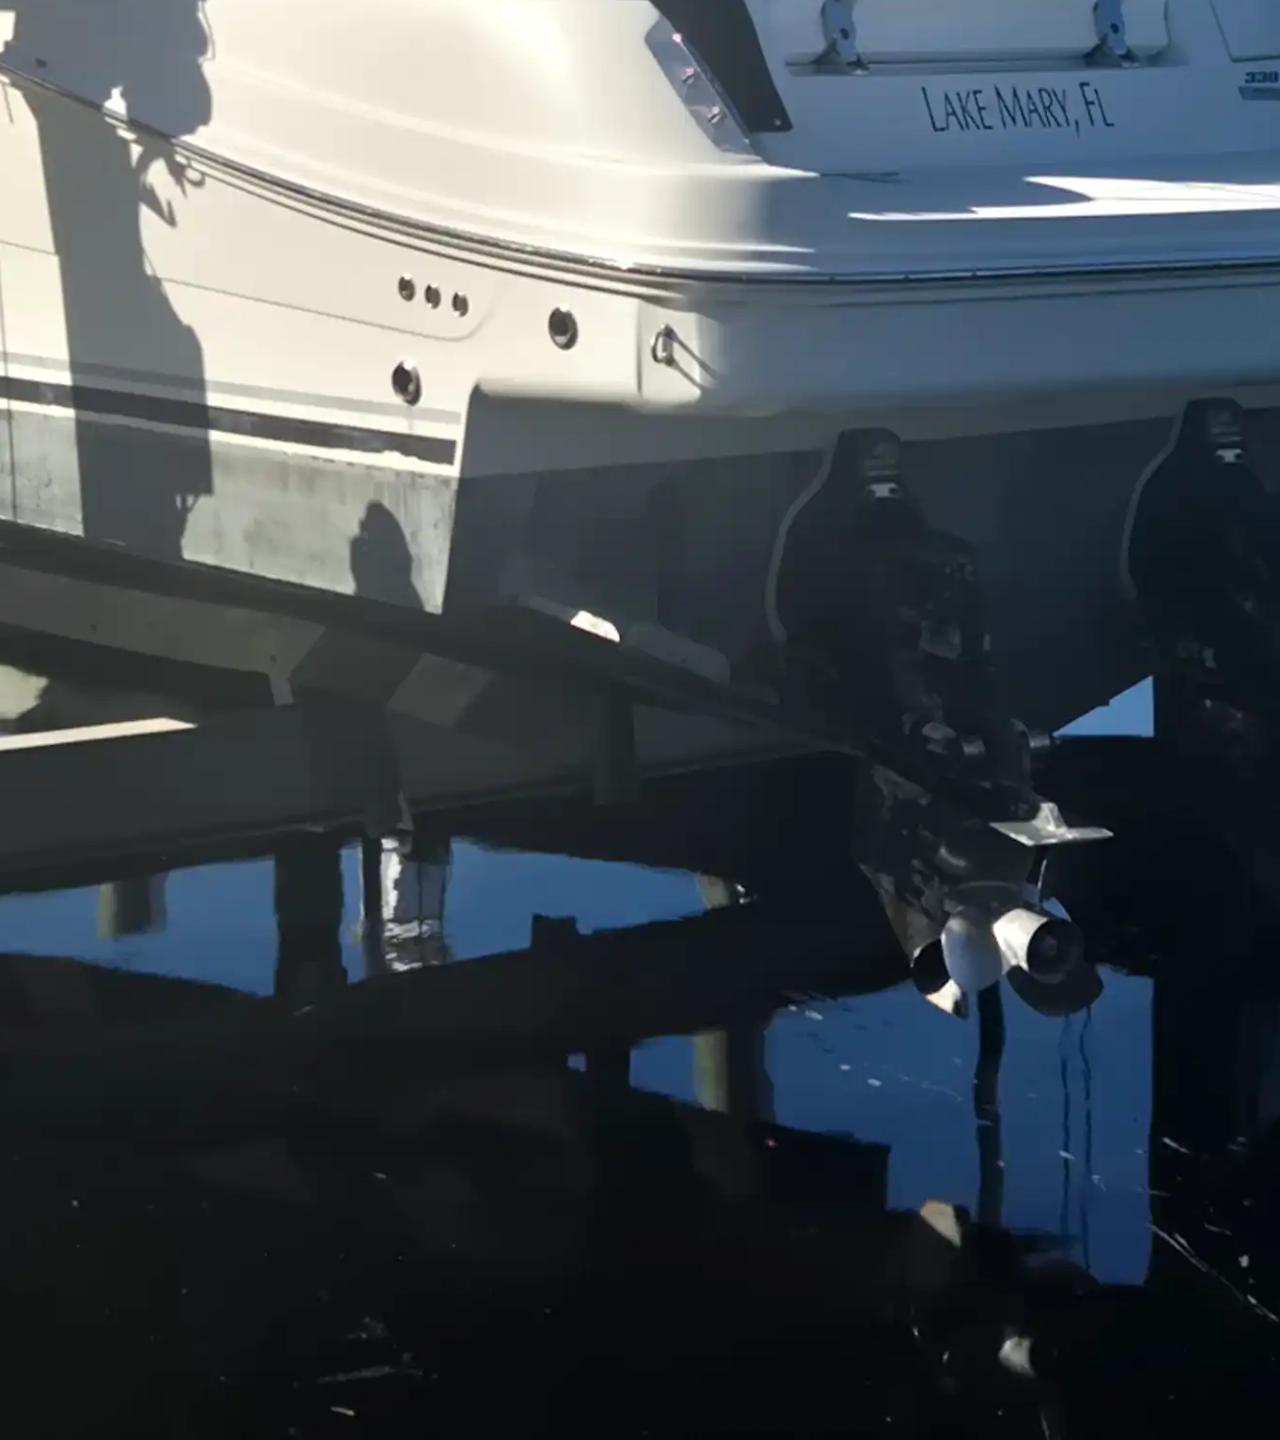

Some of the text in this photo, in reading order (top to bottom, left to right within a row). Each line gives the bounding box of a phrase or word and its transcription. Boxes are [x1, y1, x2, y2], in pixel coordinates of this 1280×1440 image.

[921, 81, 1115, 139] LAKE MARY, FL
